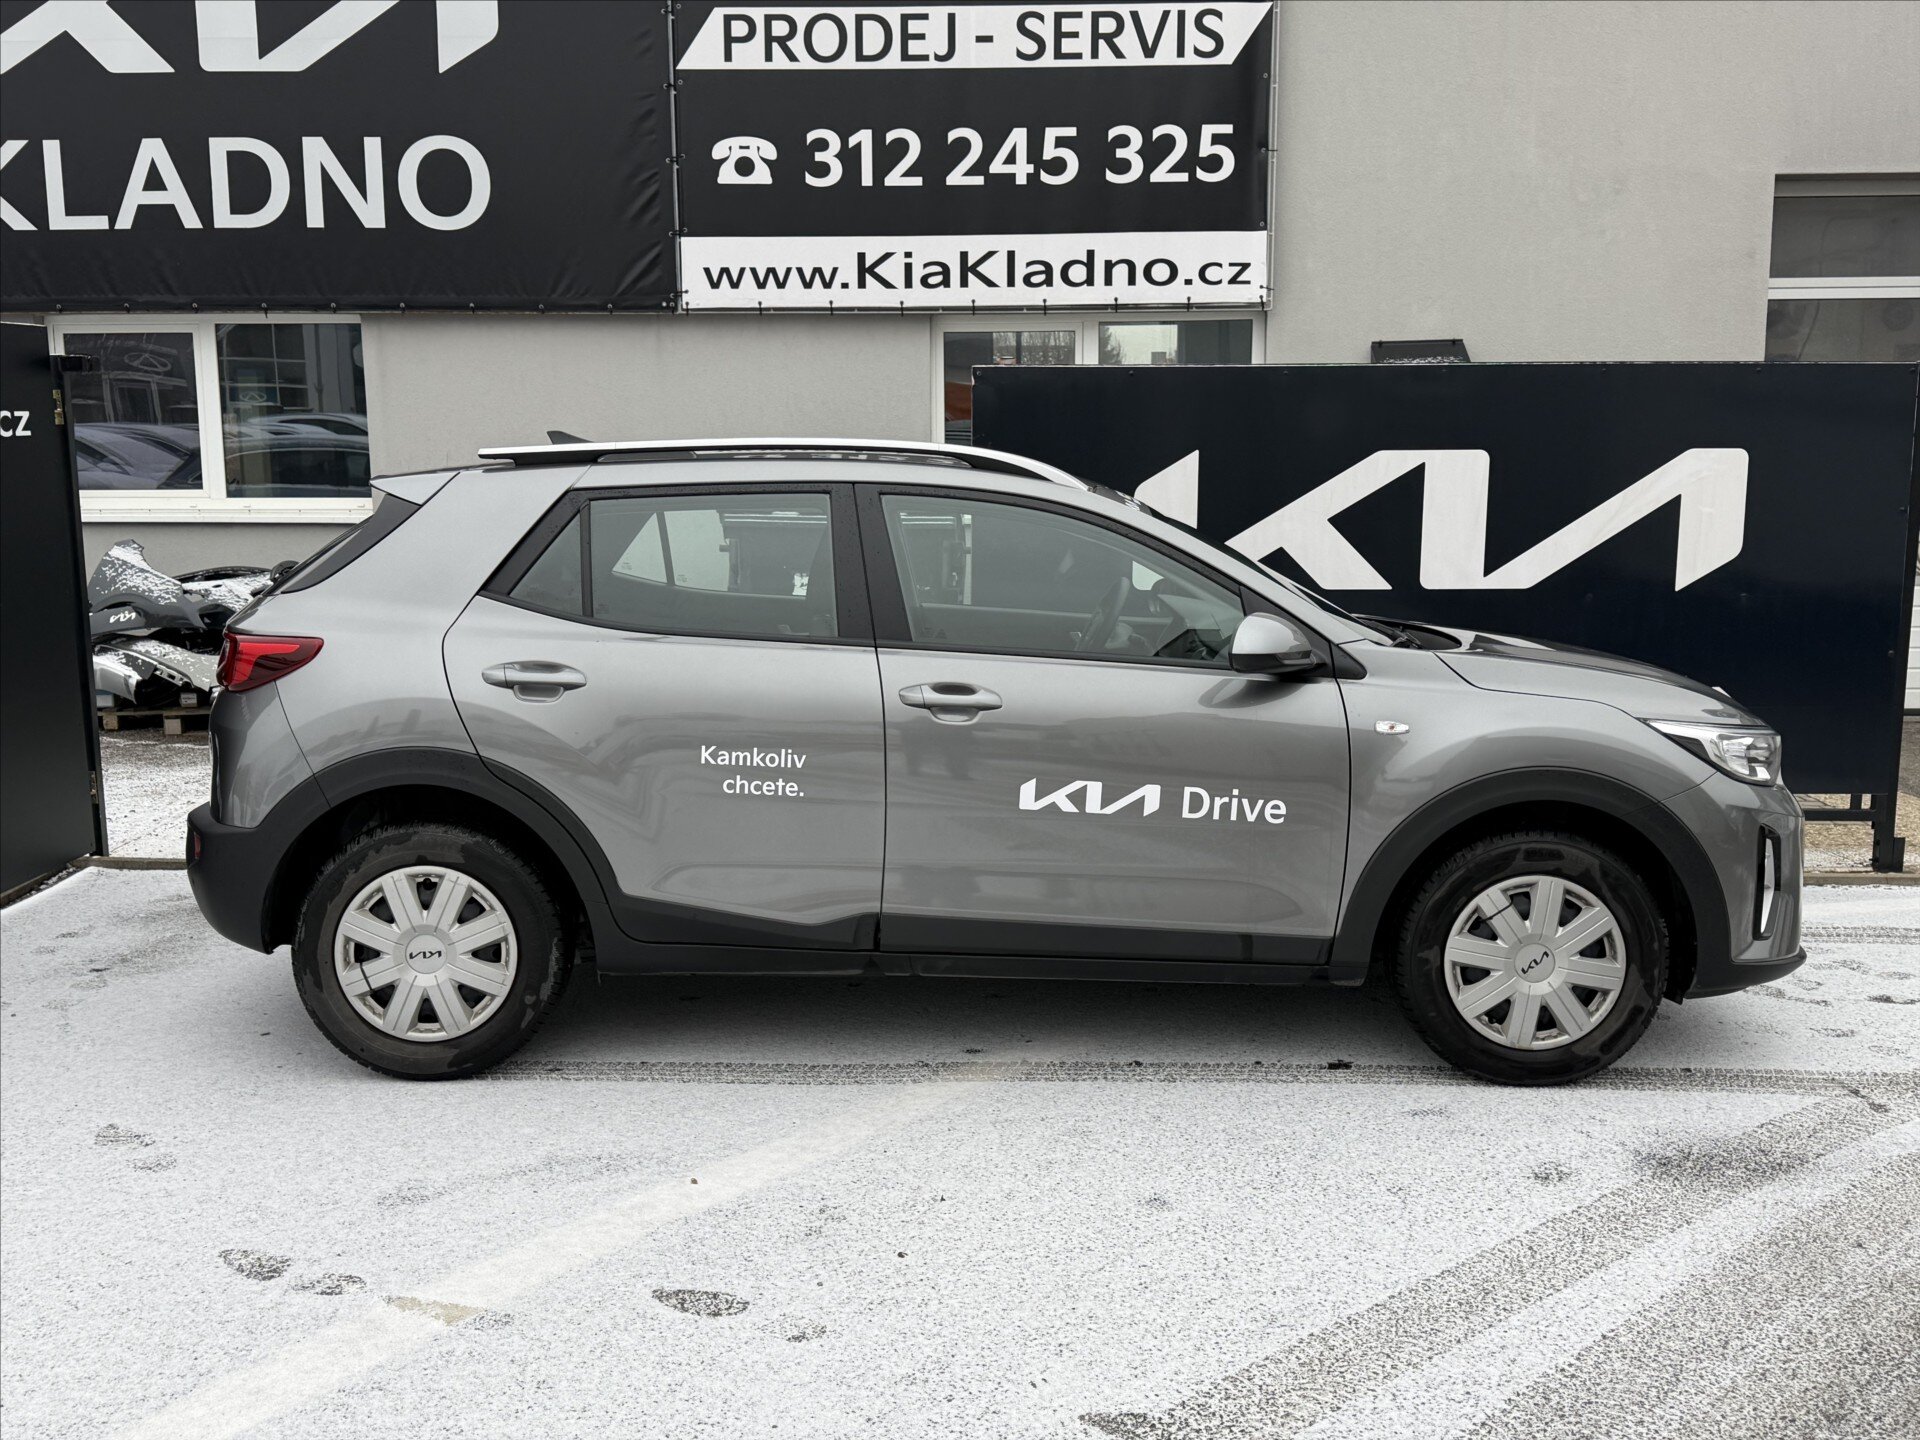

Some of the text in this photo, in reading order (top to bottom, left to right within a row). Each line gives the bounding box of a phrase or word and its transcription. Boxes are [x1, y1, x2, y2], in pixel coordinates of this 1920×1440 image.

[723, 8, 1224, 63] PRODEJ - SERVIS
[804, 123, 1236, 188] 312 245 325
[702, 249, 1252, 290] www.KiaKladno.cz
[700, 745, 807, 769] Kamkoliv
[722, 774, 804, 797] chcete.
[1018, 777, 1287, 824] KIA Drive
